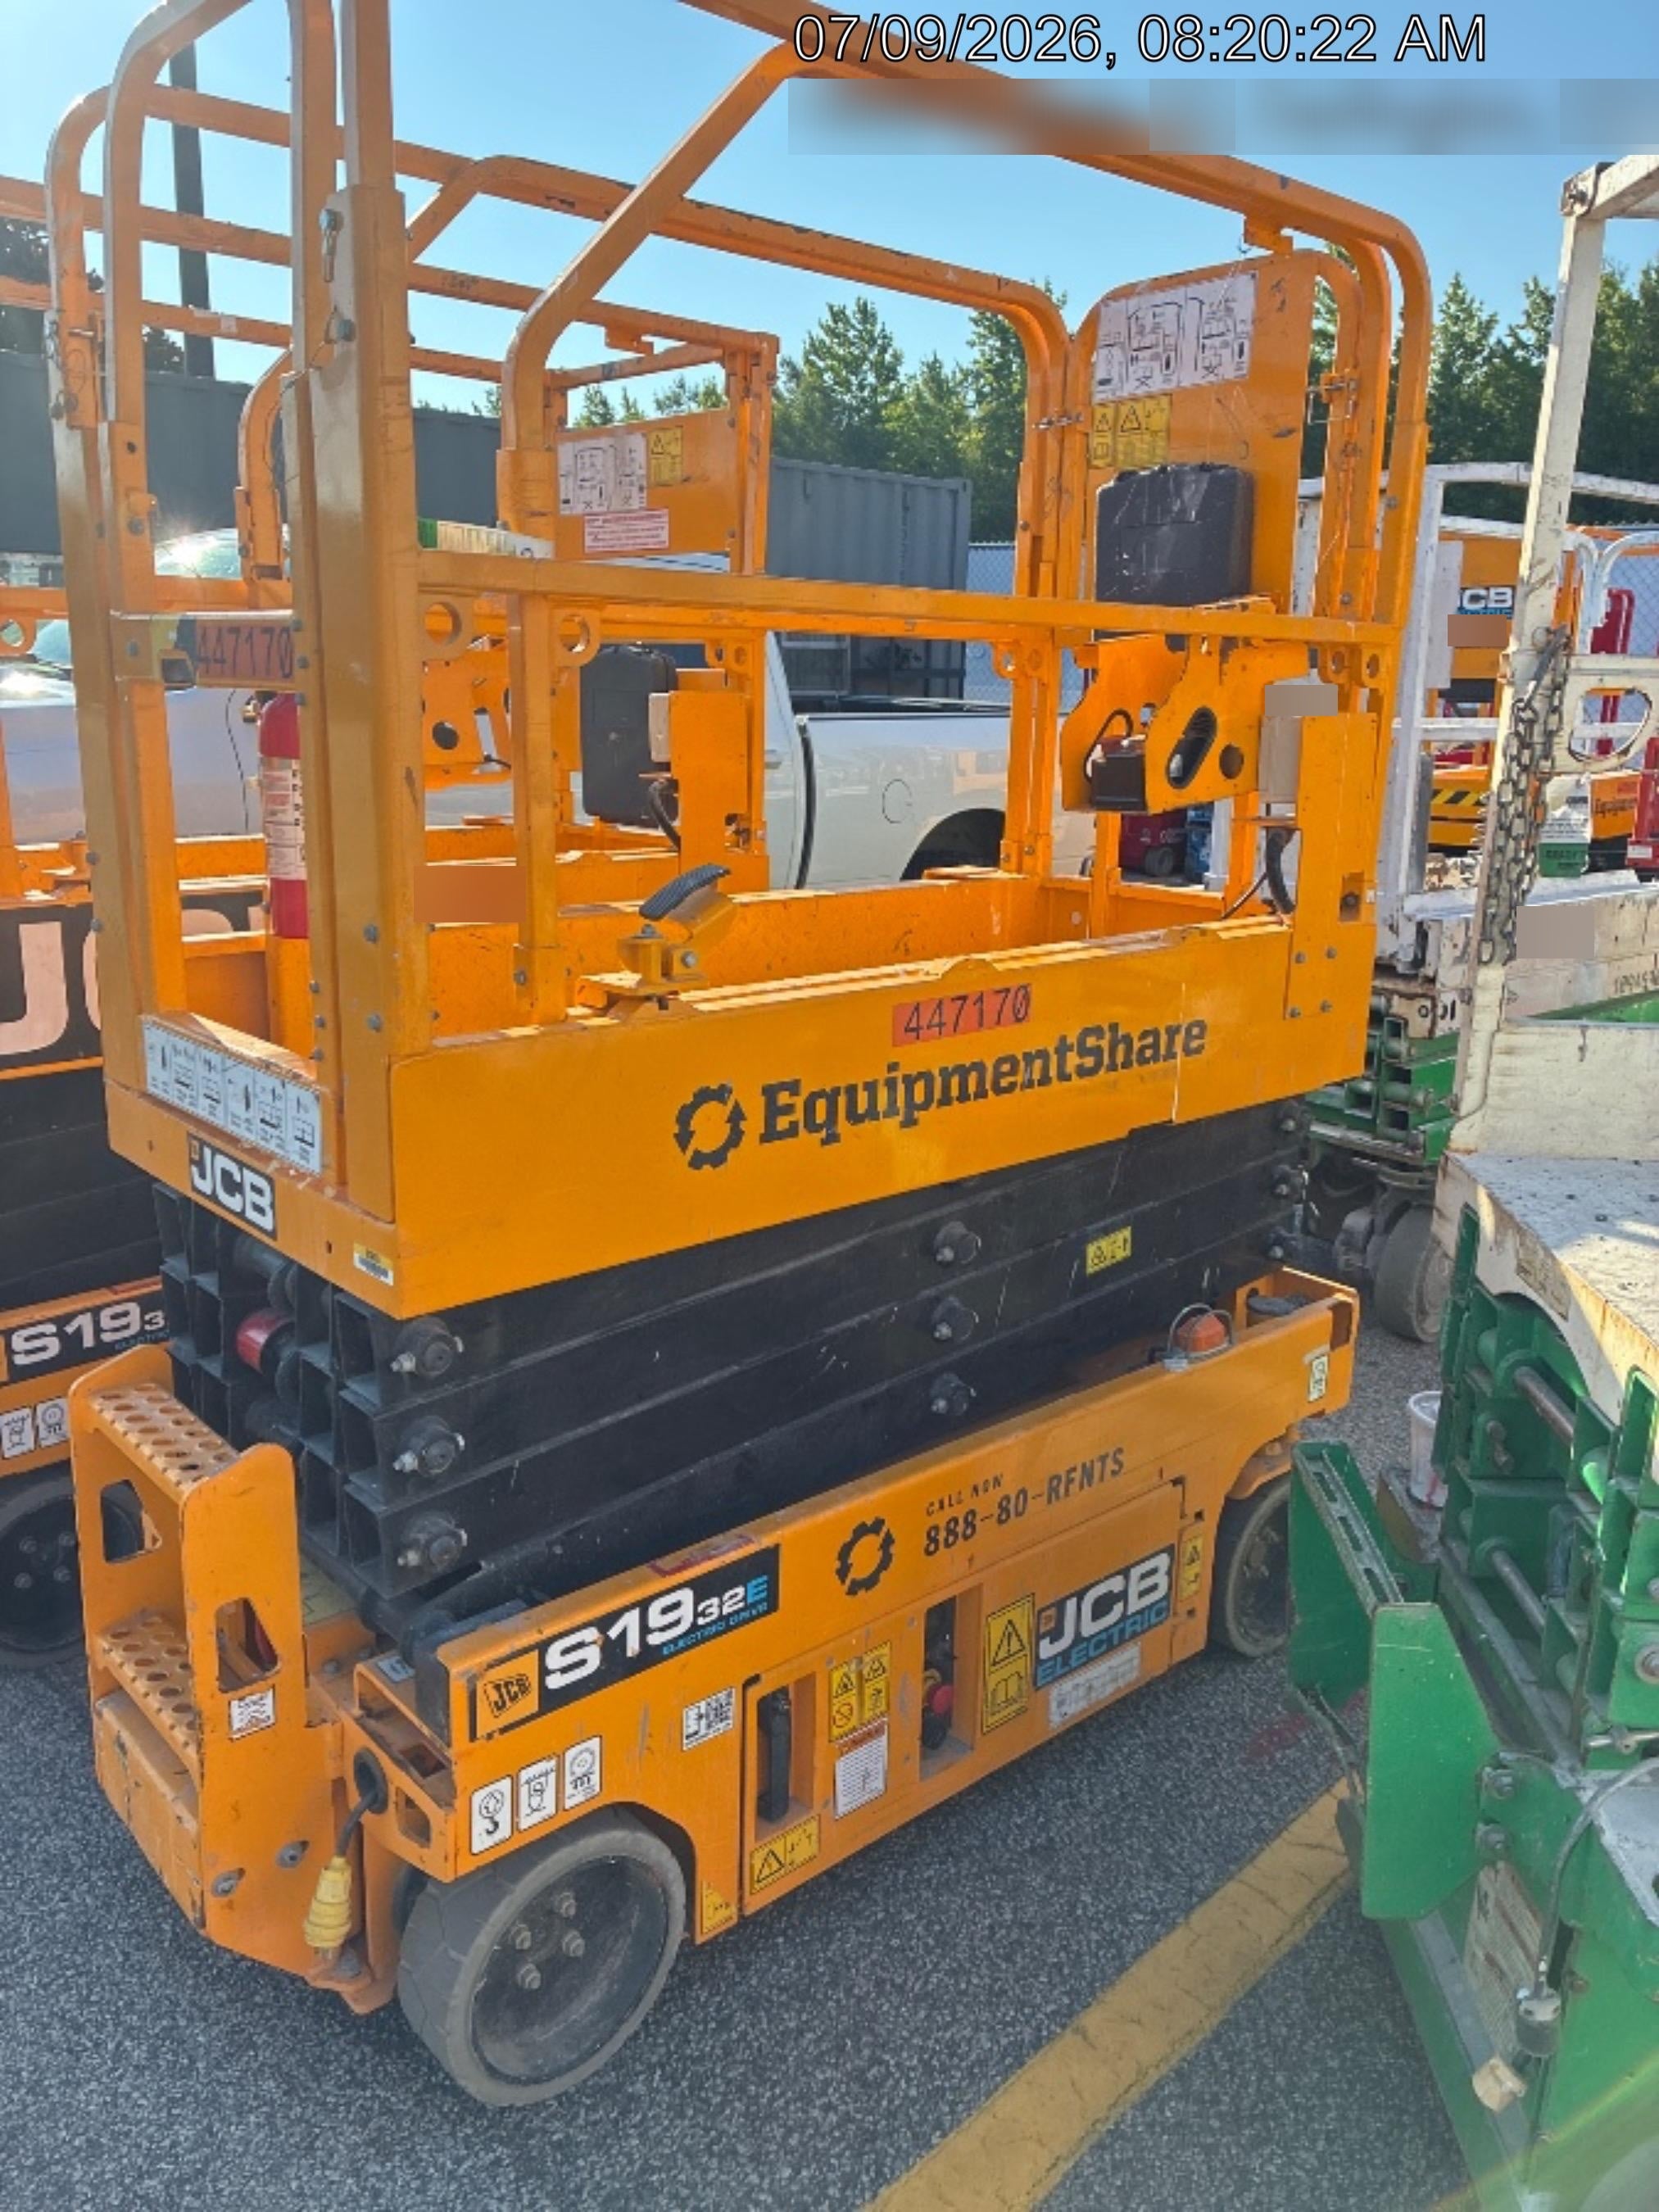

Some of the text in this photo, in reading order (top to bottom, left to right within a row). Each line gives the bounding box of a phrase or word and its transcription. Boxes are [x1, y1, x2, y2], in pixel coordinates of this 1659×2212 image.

[904, 985, 1031, 1040] 447170
[759, 1018, 1208, 1147] EquipmentShare
[191, 1145, 274, 1233] JCB
[544, 1575, 768, 1690] S1932E
[1036, 1599, 1169, 1688] ELECTRIC
[1039, 1552, 1171, 1660] JCB
